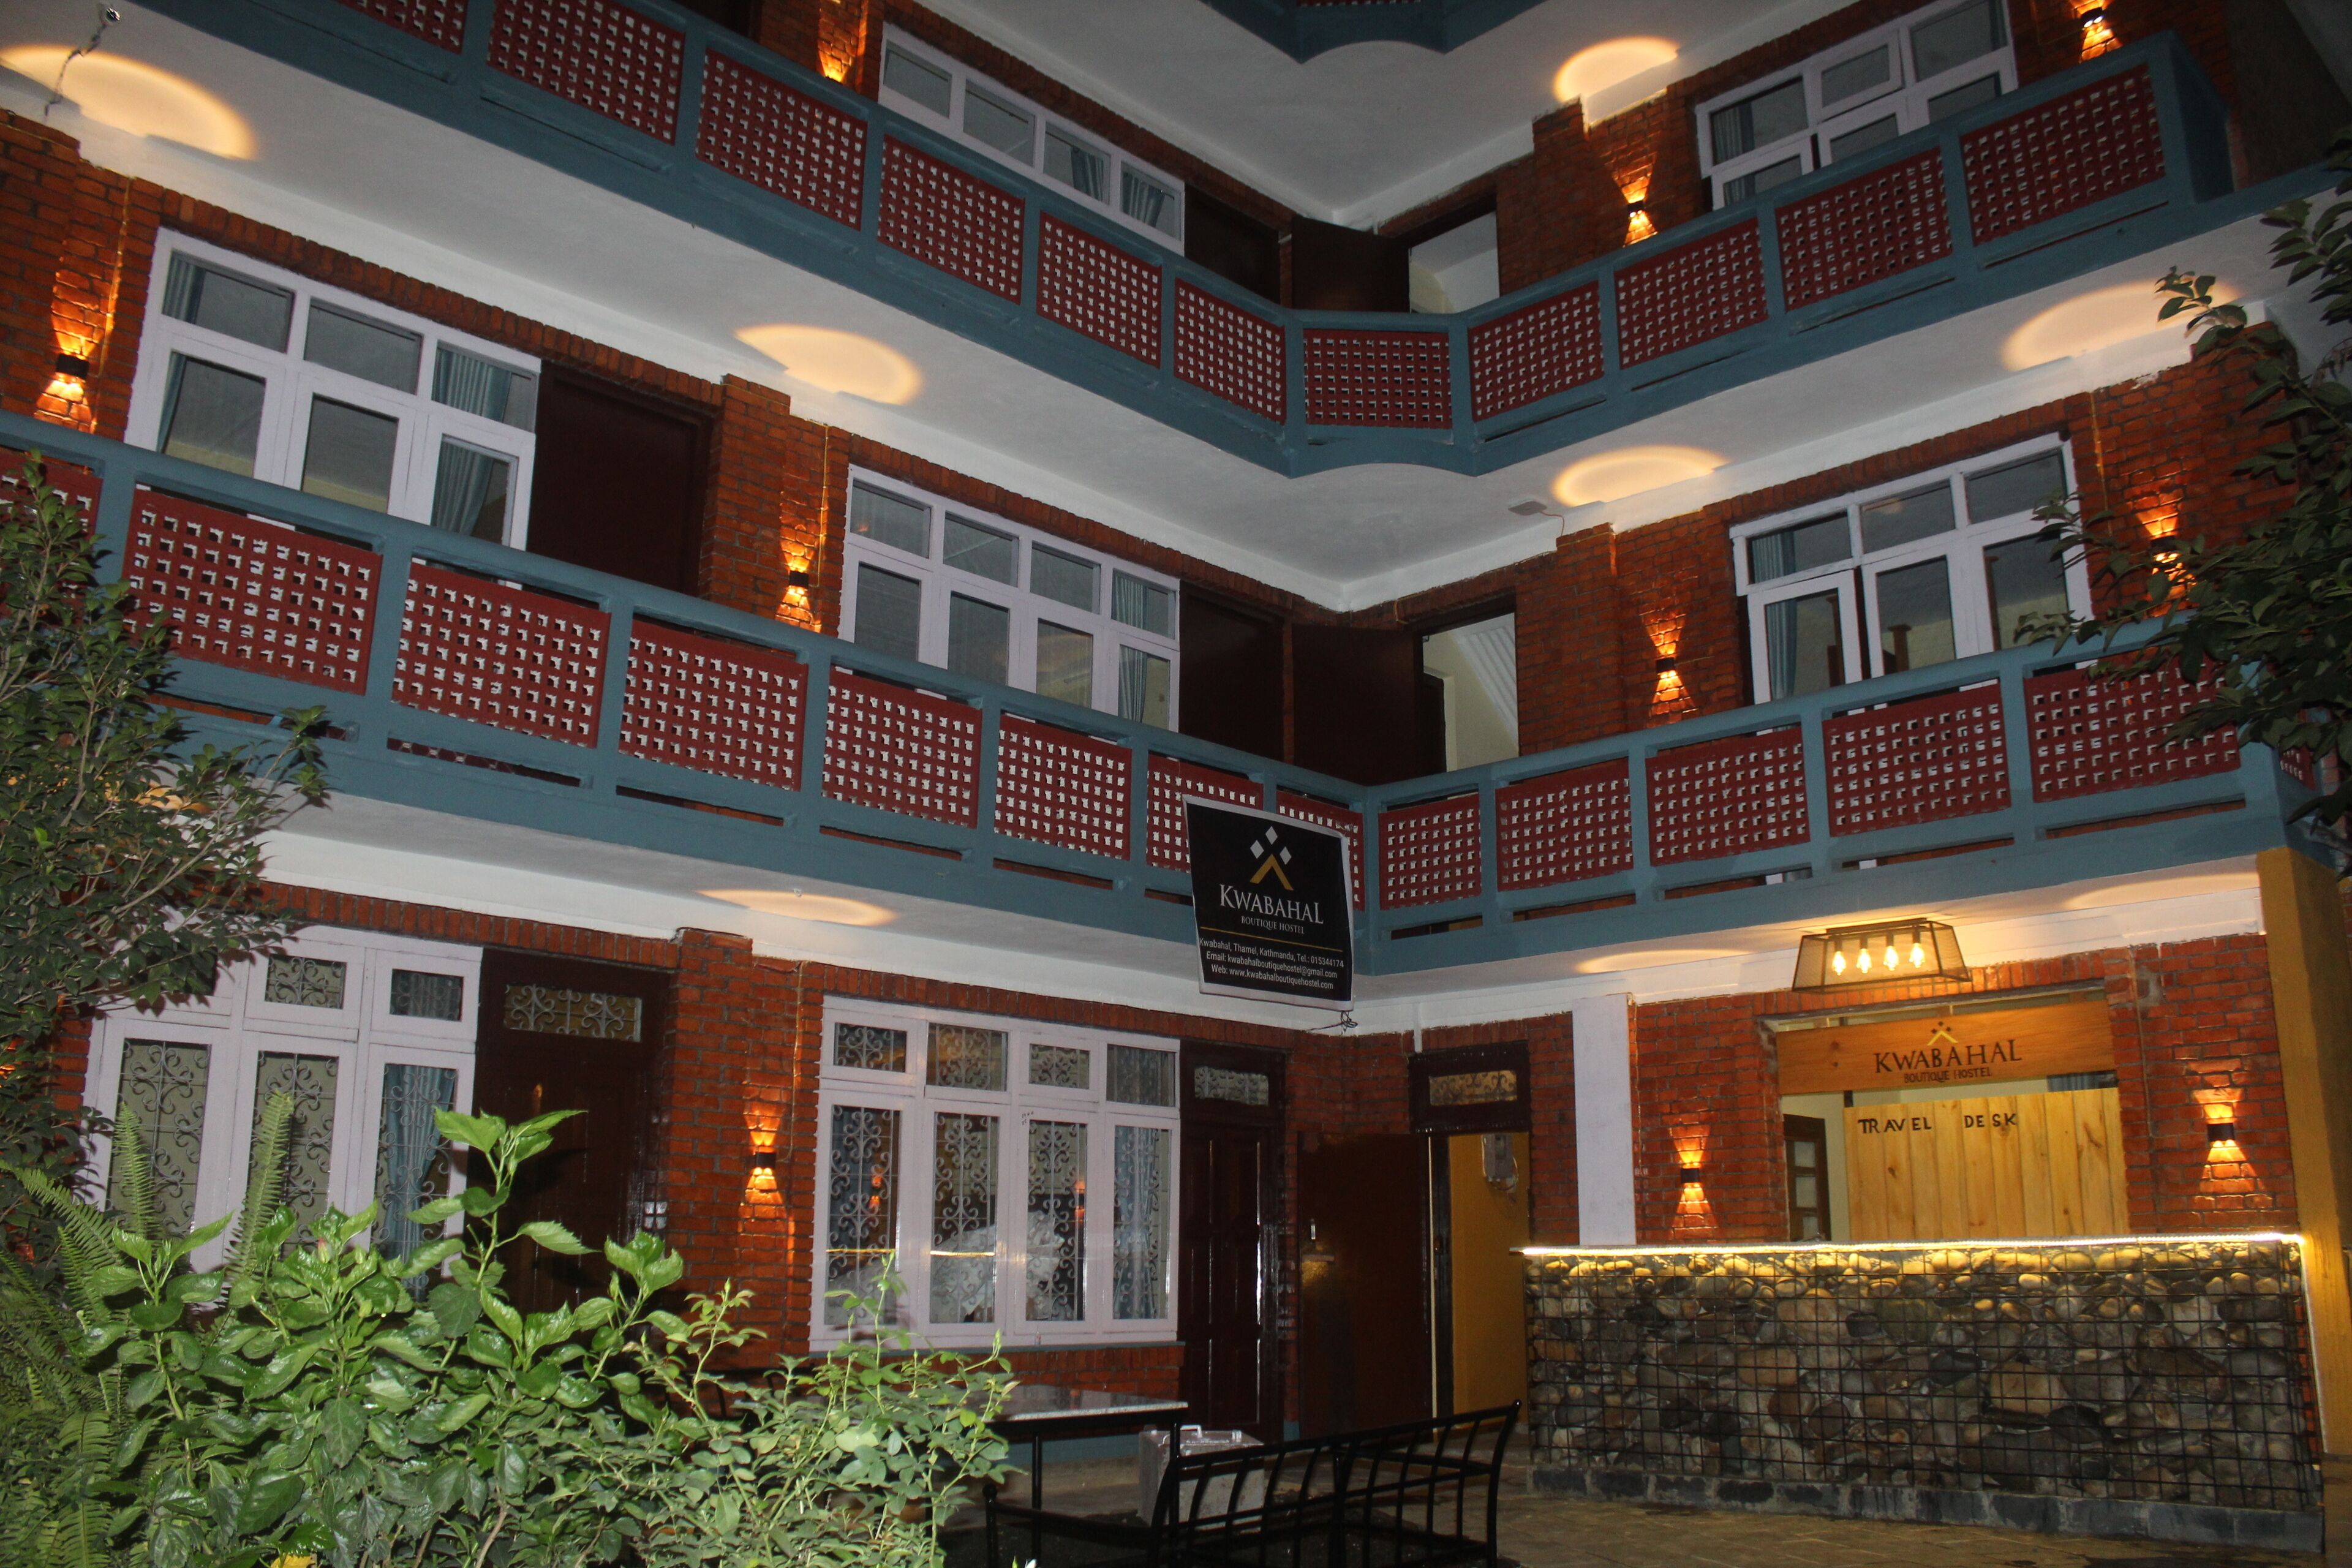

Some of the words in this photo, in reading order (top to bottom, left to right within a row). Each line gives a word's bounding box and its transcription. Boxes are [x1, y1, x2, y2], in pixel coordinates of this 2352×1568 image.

[1219, 884, 1324, 924] KWABAHAL
[1241, 916, 1277, 930] BOUTIQUE
[1279, 922, 1305, 934] HOSTEL
[1199, 938, 1232, 952] Kwabahal,
[1233, 943, 1259, 956] Thamel,
[1259, 948, 1296, 962] Kathmandu,
[1311, 956, 1344, 968] 015344174
[1206, 951, 1226, 962] Email:
[1227, 955, 1338, 979] kwabahalboutiquehostel@gmail.com
[1211, 964, 1228, 974] Web:
[1229, 968, 1334, 990] www.kwabahalboutiquehostel.com
[1873, 1039, 2022, 1073] KWABAHAL
[1904, 1070, 1950, 1083] BOUTIQUE
[1954, 1067, 1992, 1079] HOSTEL
[1858, 1117, 1932, 1133] TRAVEL
[1964, 1113, 2017, 1128] DESK
